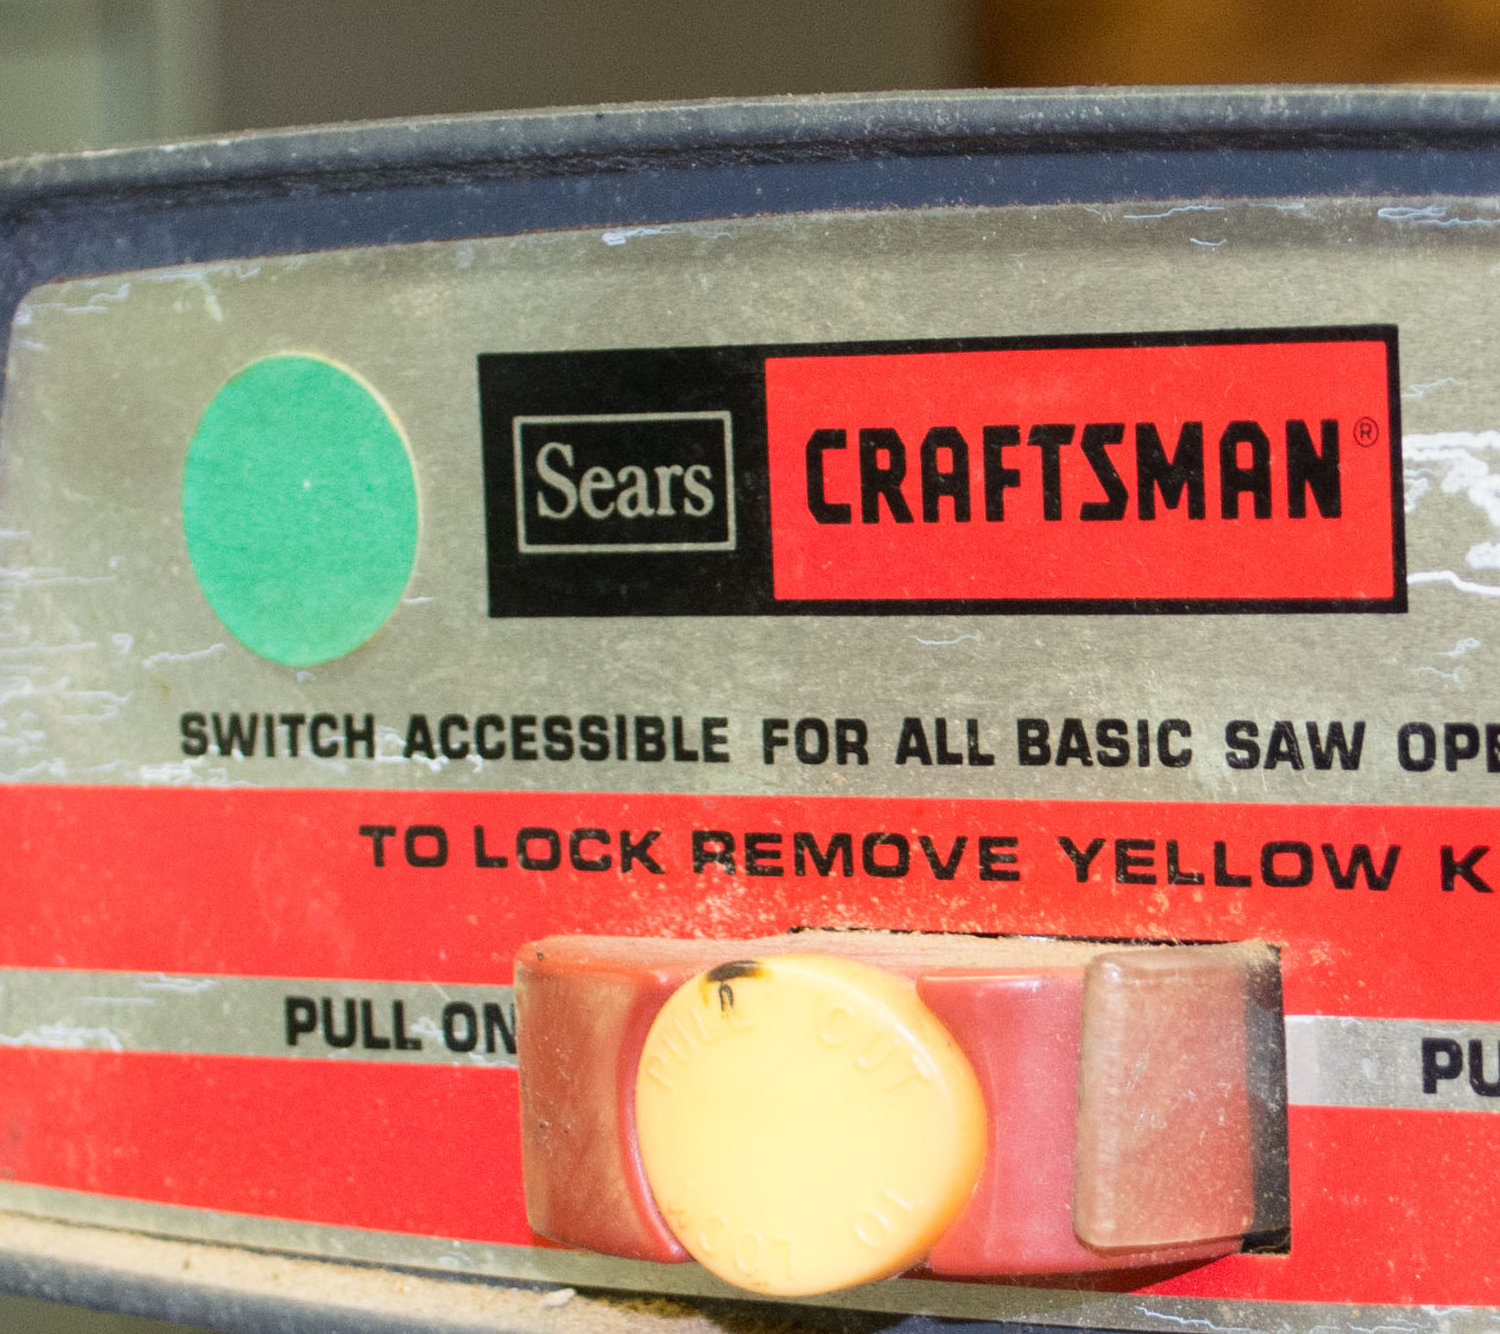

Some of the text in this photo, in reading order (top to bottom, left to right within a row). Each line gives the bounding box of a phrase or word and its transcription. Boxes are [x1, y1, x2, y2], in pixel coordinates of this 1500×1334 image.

[536, 442, 714, 520] Sears
[179, 712, 375, 759] SWITCH
[402, 713, 730, 764] ACCESSIBLE
[762, 717, 870, 766] FOR
[894, 716, 995, 767] ALL
[1016, 717, 1192, 769] BASIC
[1225, 720, 1366, 772] SAW
[358, 824, 449, 868] TO
[473, 825, 664, 875] LOCK
[691, 830, 1021, 882] REMOVE
[1058, 836, 1401, 892] YELLOW
[284, 996, 518, 1055] PULL ON
[819, 1004, 929, 1094] OUT
